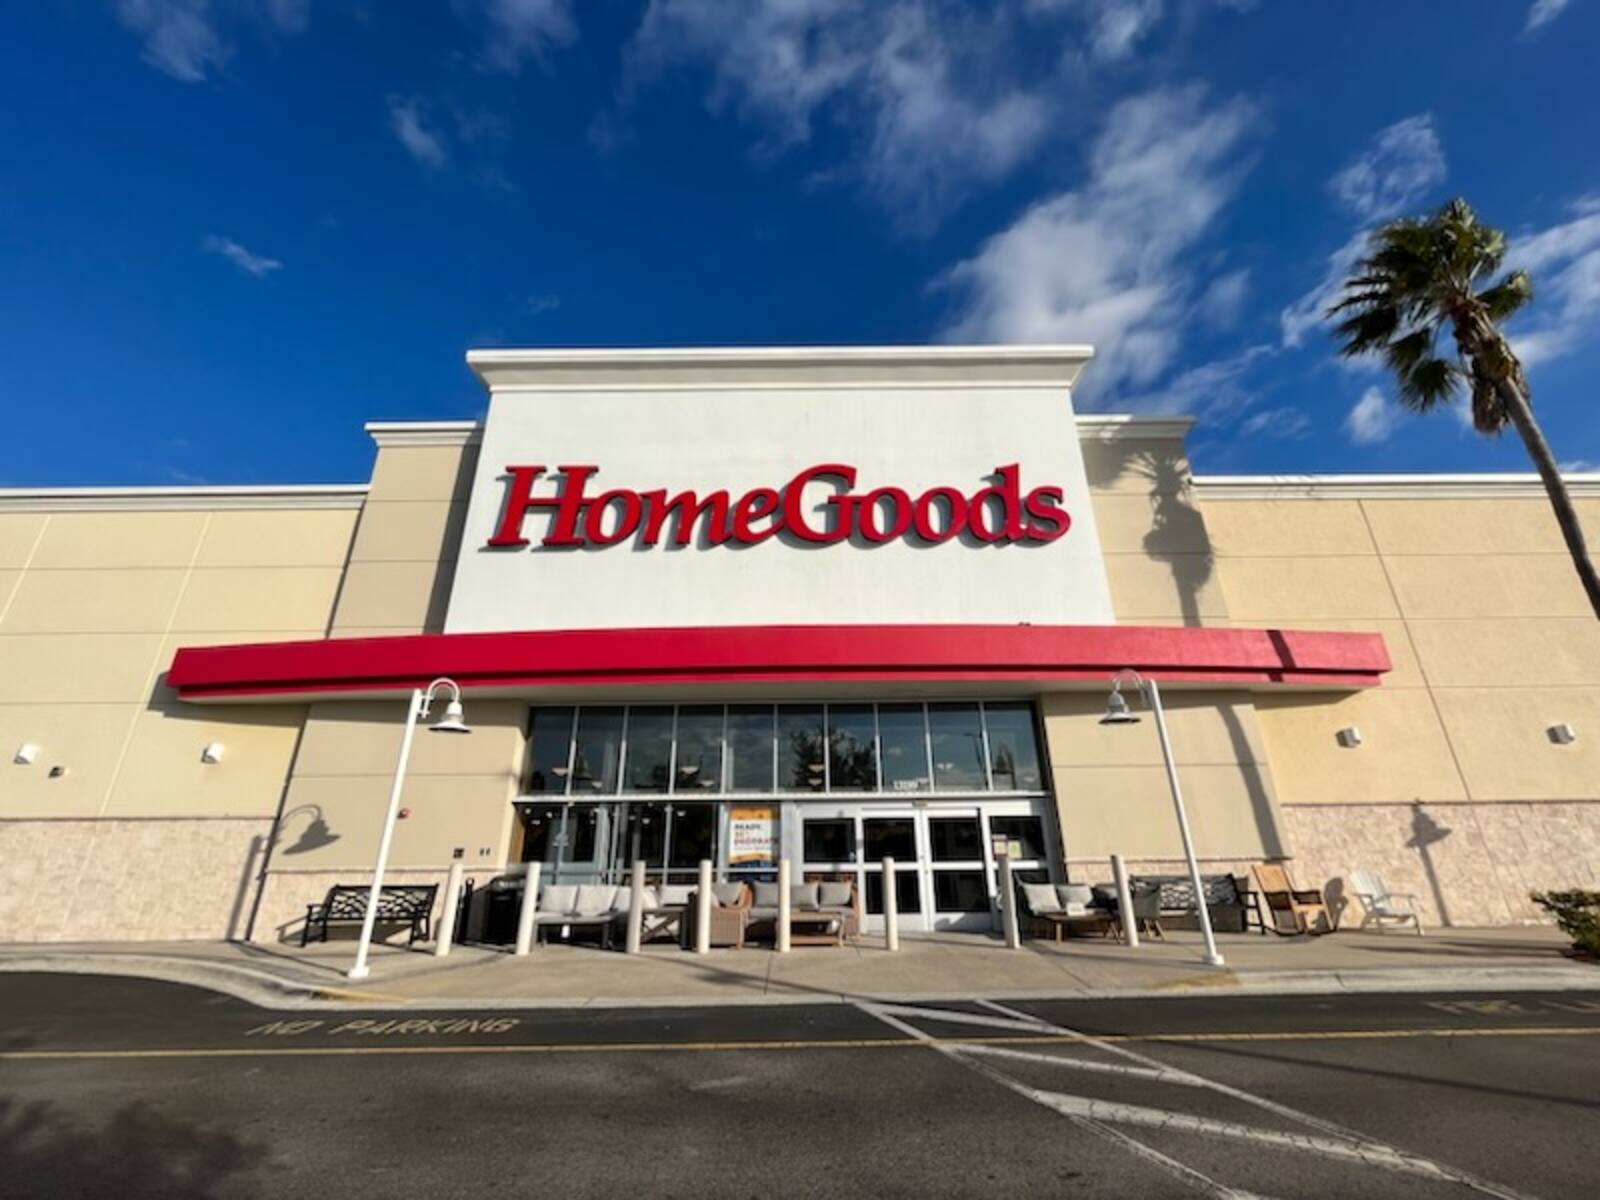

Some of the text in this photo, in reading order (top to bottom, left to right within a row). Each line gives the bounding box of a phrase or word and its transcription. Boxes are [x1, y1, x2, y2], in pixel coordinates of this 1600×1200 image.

[487, 462, 1071, 546] HomeGoods
[245, 1018, 520, 1036] NO PARKING
